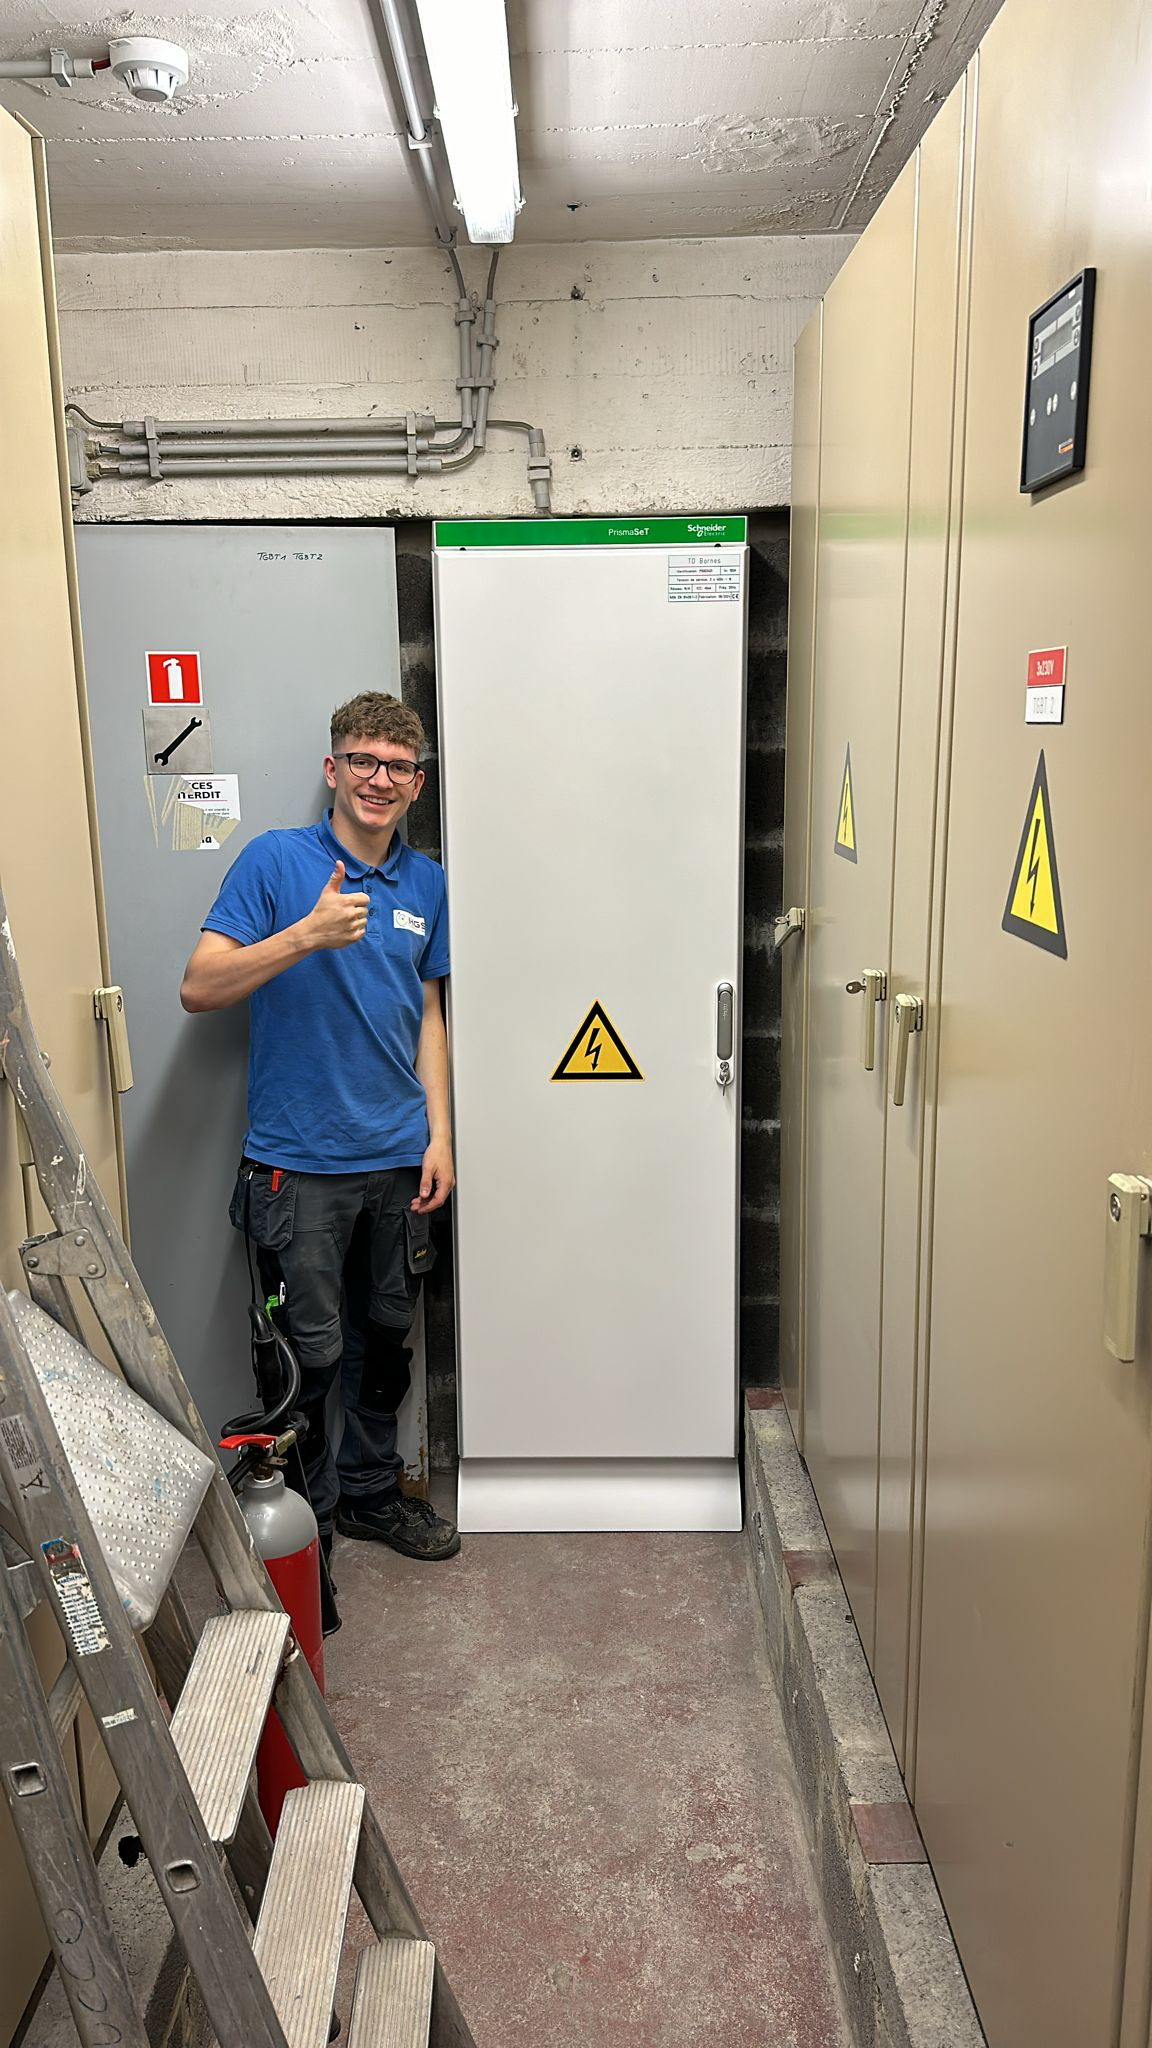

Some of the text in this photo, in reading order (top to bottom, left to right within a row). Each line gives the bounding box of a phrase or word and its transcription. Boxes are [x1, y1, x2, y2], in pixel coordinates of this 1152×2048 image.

[608, 527, 650, 536] PrismaSeT
[687, 524, 727, 535] Schneider
[292, 552, 323, 561] TGBT2
[699, 557, 721, 565] Bornes
[1050, 696, 1055, 714] 2
[189, 781, 213, 789] CES
